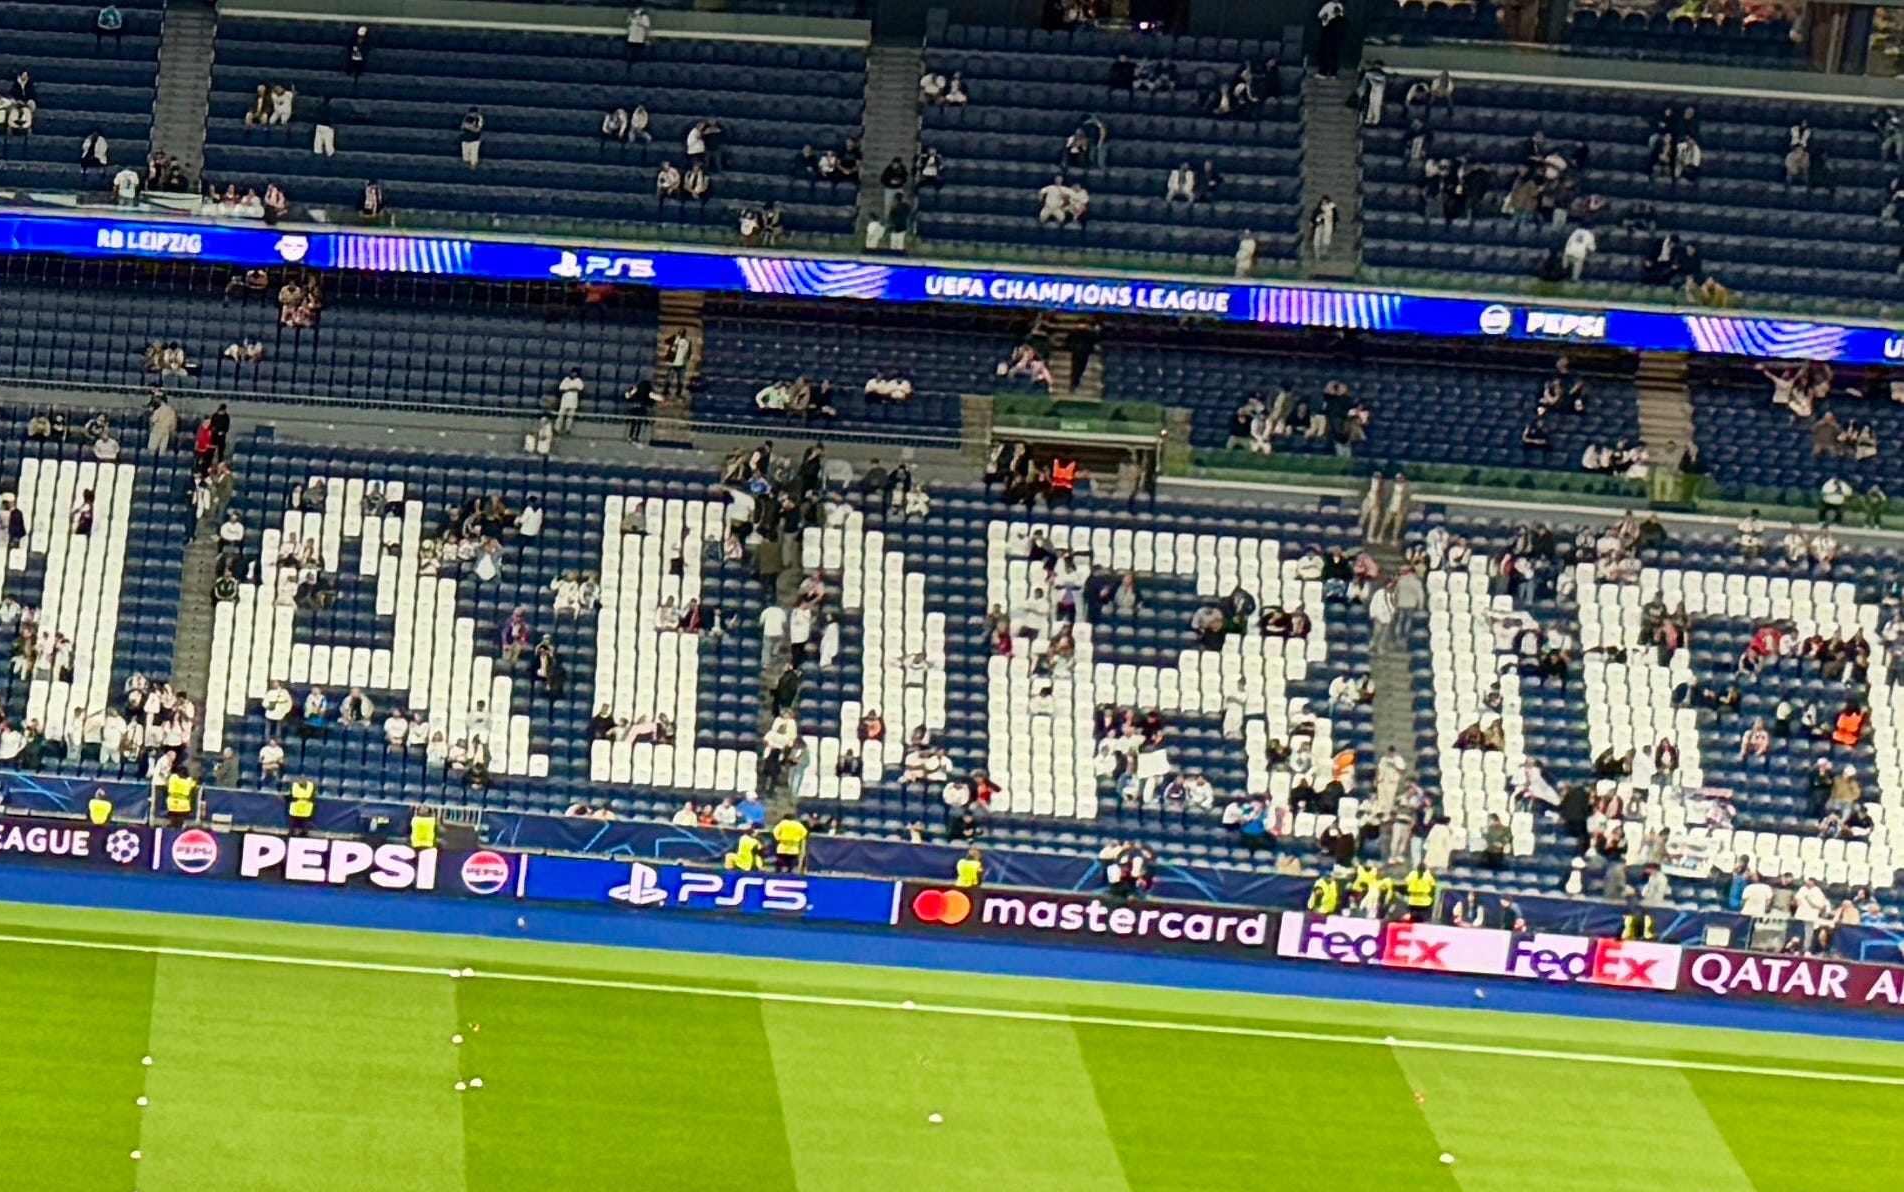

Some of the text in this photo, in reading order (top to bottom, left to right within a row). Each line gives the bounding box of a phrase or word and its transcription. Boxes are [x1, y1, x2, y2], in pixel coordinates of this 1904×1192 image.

[97, 228, 203, 255] RB LEIPZIG
[924, 275, 1231, 313] UEFA CHAMPIONS LEAGUE
[1525, 313, 1607, 338] PEPSI
[240, 832, 438, 890] PEPSI
[678, 873, 808, 911] PS5
[982, 897, 1267, 945] mastercard
[1300, 915, 1451, 969] FedEx
[1508, 930, 1657, 985] FedEx
[1692, 953, 1849, 998] QATAR
